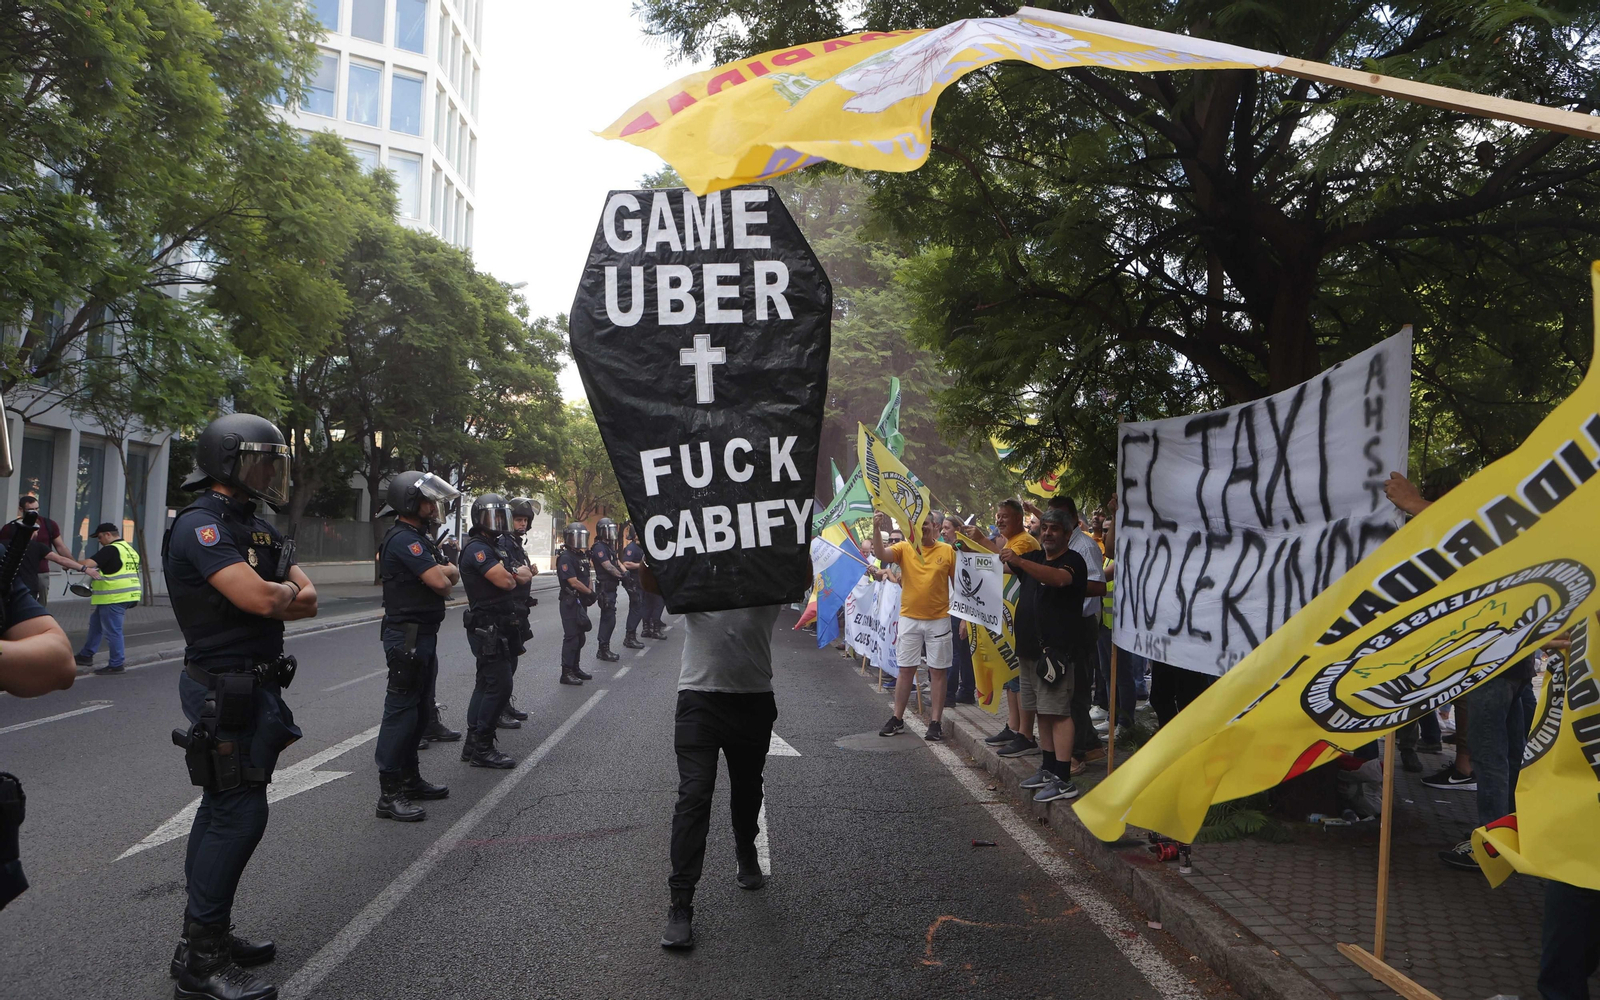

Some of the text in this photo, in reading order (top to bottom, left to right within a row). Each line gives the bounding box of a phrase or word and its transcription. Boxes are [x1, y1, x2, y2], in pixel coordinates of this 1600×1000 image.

[603, 189, 772, 253] GAME
[604, 260, 794, 327] UBER
[640, 436, 801, 496] FUCK
[1121, 373, 1335, 535] EL TAXI
[644, 498, 813, 561] CABIFY
[998, 641, 1020, 671] TAXI
